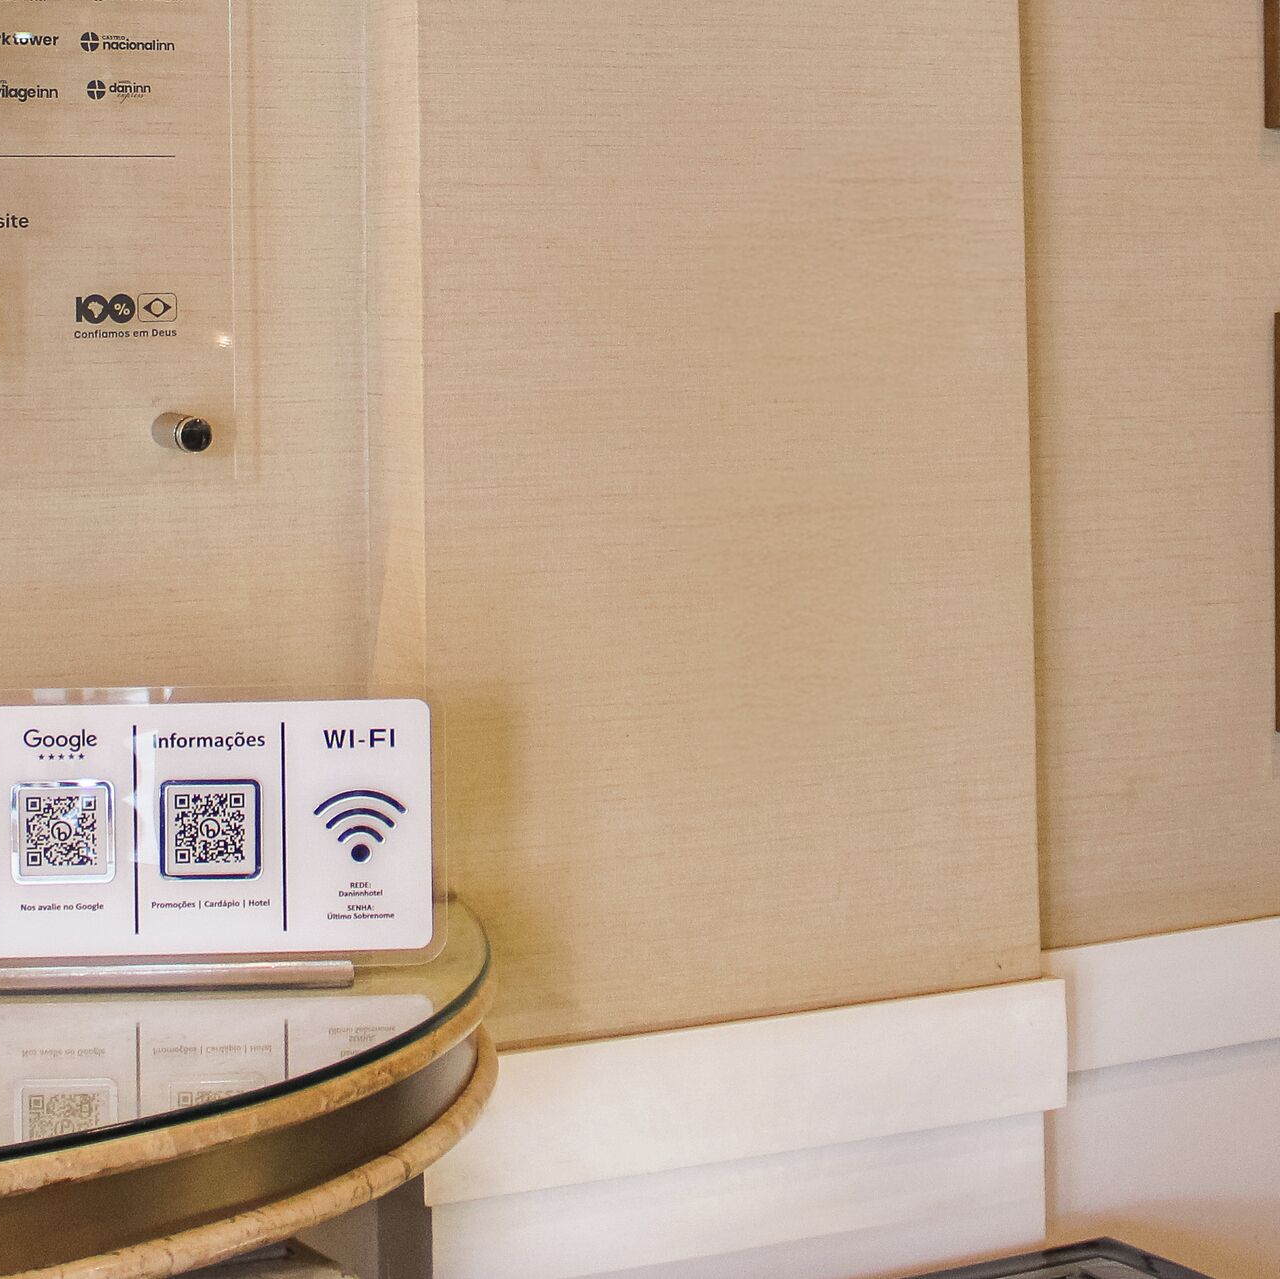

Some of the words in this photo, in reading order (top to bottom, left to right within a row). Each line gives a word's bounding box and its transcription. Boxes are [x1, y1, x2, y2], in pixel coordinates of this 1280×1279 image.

[102, 38, 175, 51] nacionalinn
[74, 329, 130, 339] Confiamos
[152, 328, 177, 337] Deus
[23, 729, 98, 752] Google
[153, 732, 266, 751] Informações
[323, 728, 396, 749] WI-FI
[20, 903, 36, 911] Nos
[38, 903, 61, 911] avalie
[76, 902, 104, 912] Google
[151, 900, 196, 910] Promoções
[204, 898, 240, 909] Cardápio
[248, 899, 271, 907] Hotel
[353, 912, 395, 920] Sobrenome
